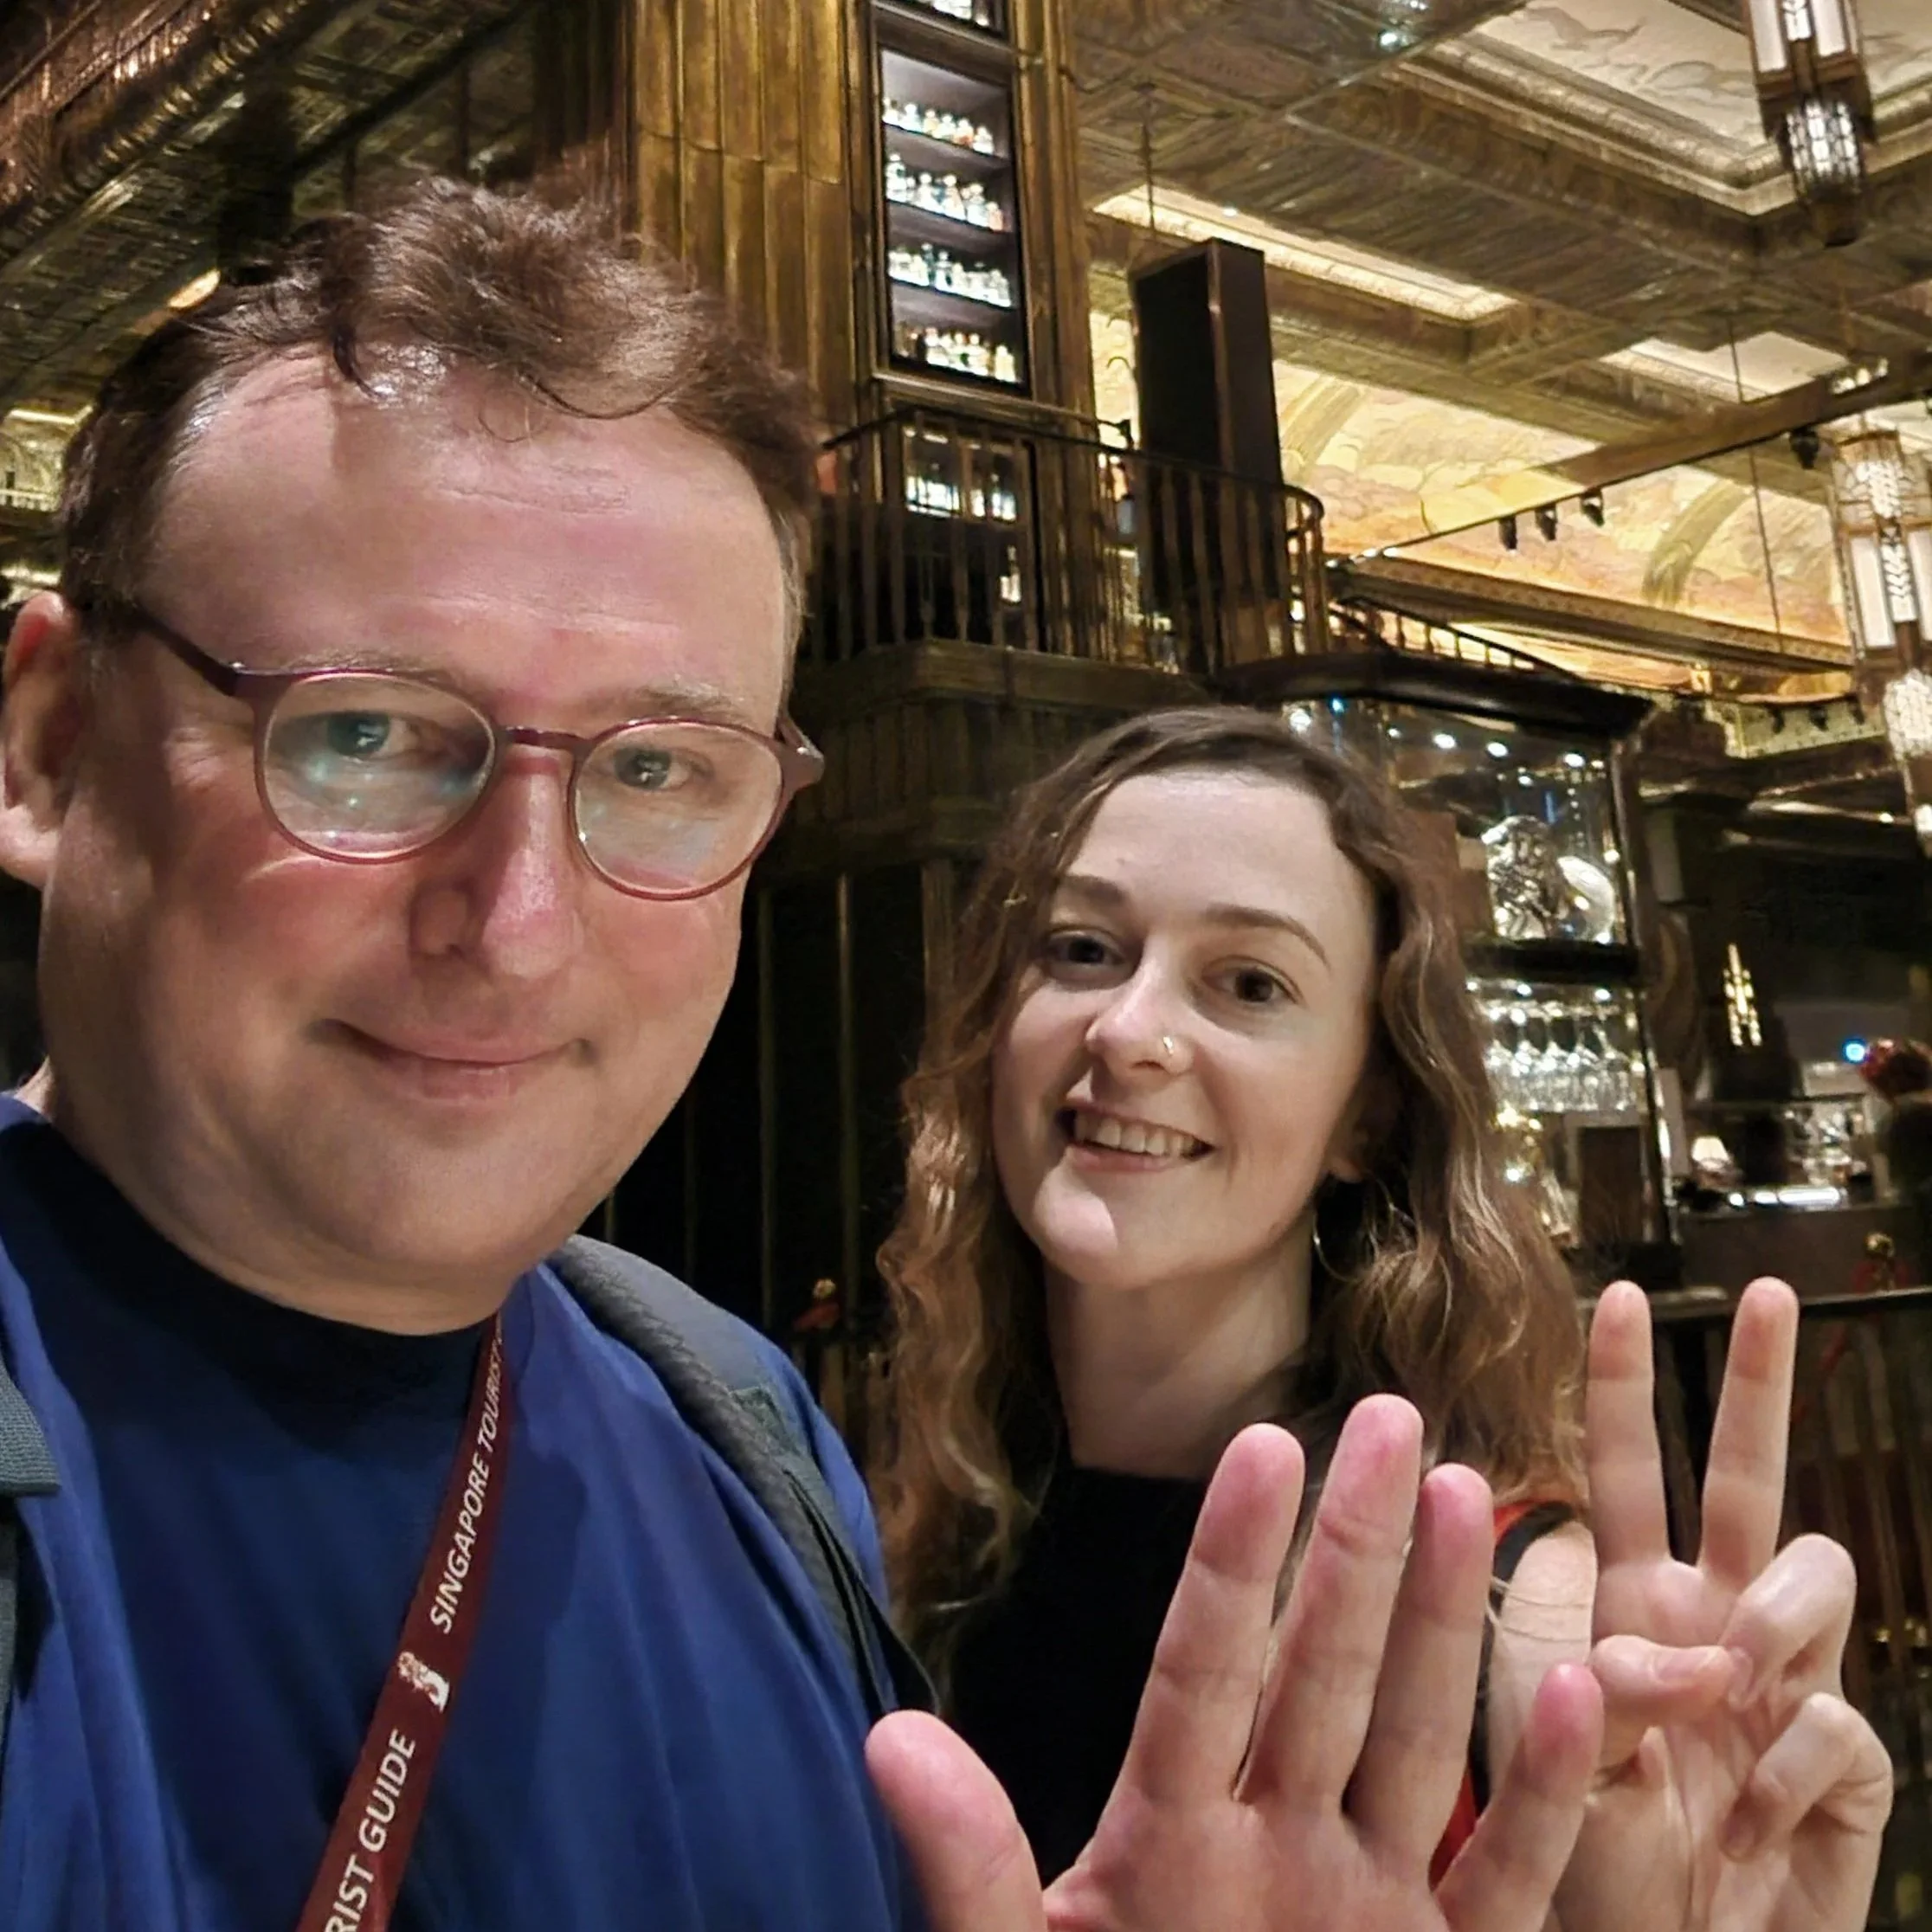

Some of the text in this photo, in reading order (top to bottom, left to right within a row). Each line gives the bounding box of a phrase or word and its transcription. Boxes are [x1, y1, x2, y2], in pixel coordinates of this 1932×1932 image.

[430, 1339, 502, 1634] SINGAPORE TOURIST
[358, 1729, 416, 1852] GUIDE
